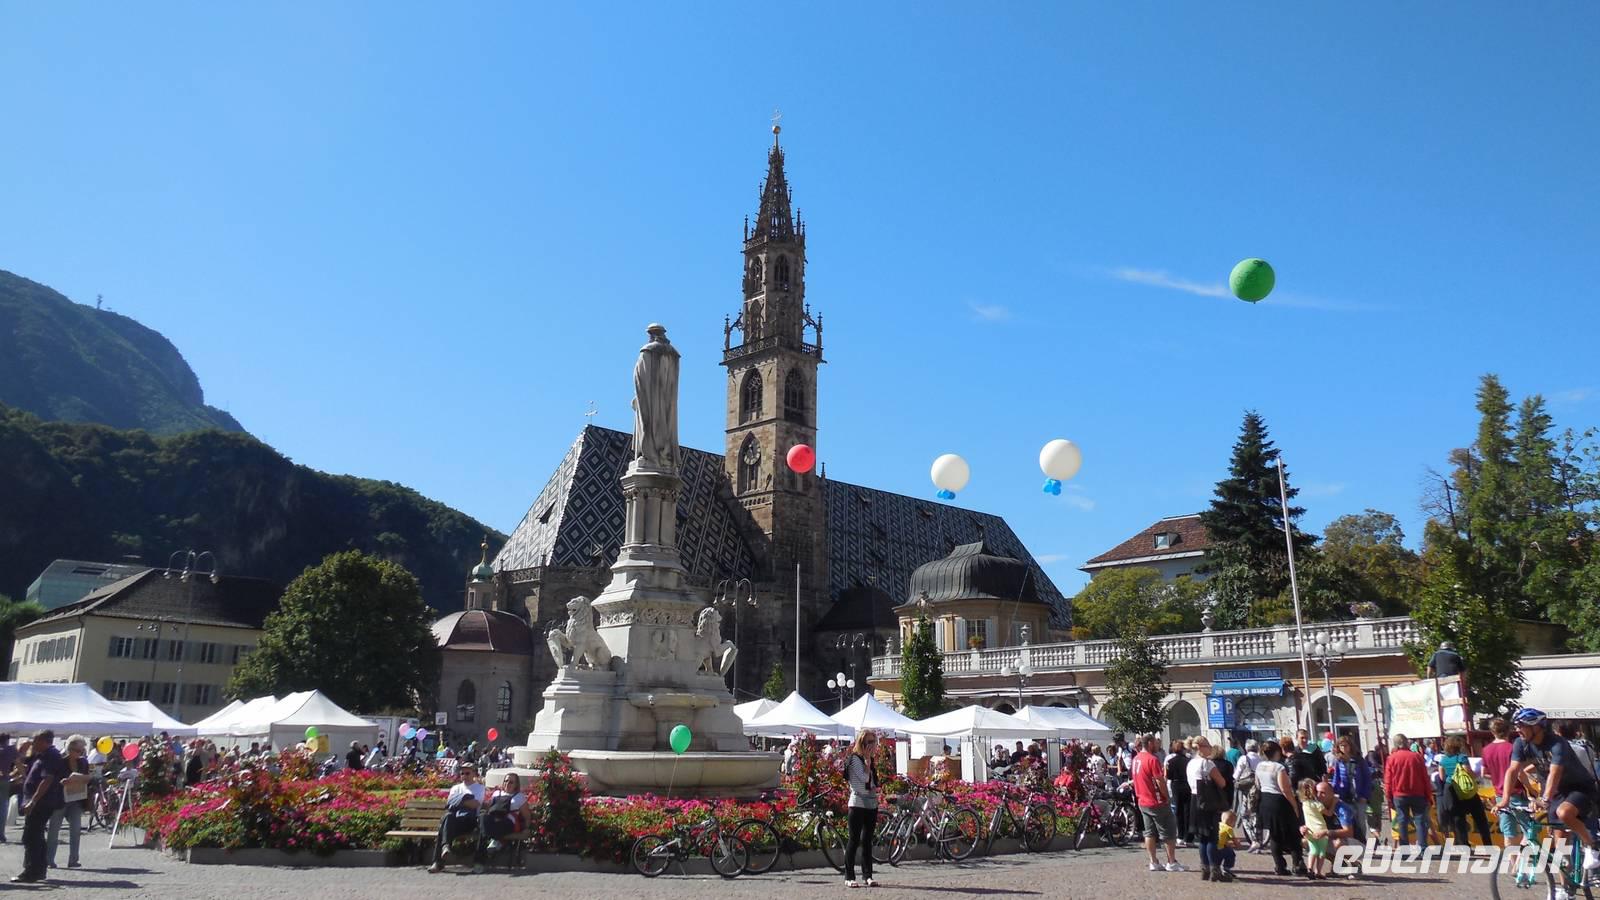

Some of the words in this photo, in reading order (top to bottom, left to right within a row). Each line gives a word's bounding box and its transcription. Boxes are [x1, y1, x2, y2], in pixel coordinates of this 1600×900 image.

[1216, 671, 1249, 679] TABACCHI
[1252, 670, 1278, 678] TABAK
[1210, 702, 1220, 714] P
[1225, 702, 1232, 714] P
